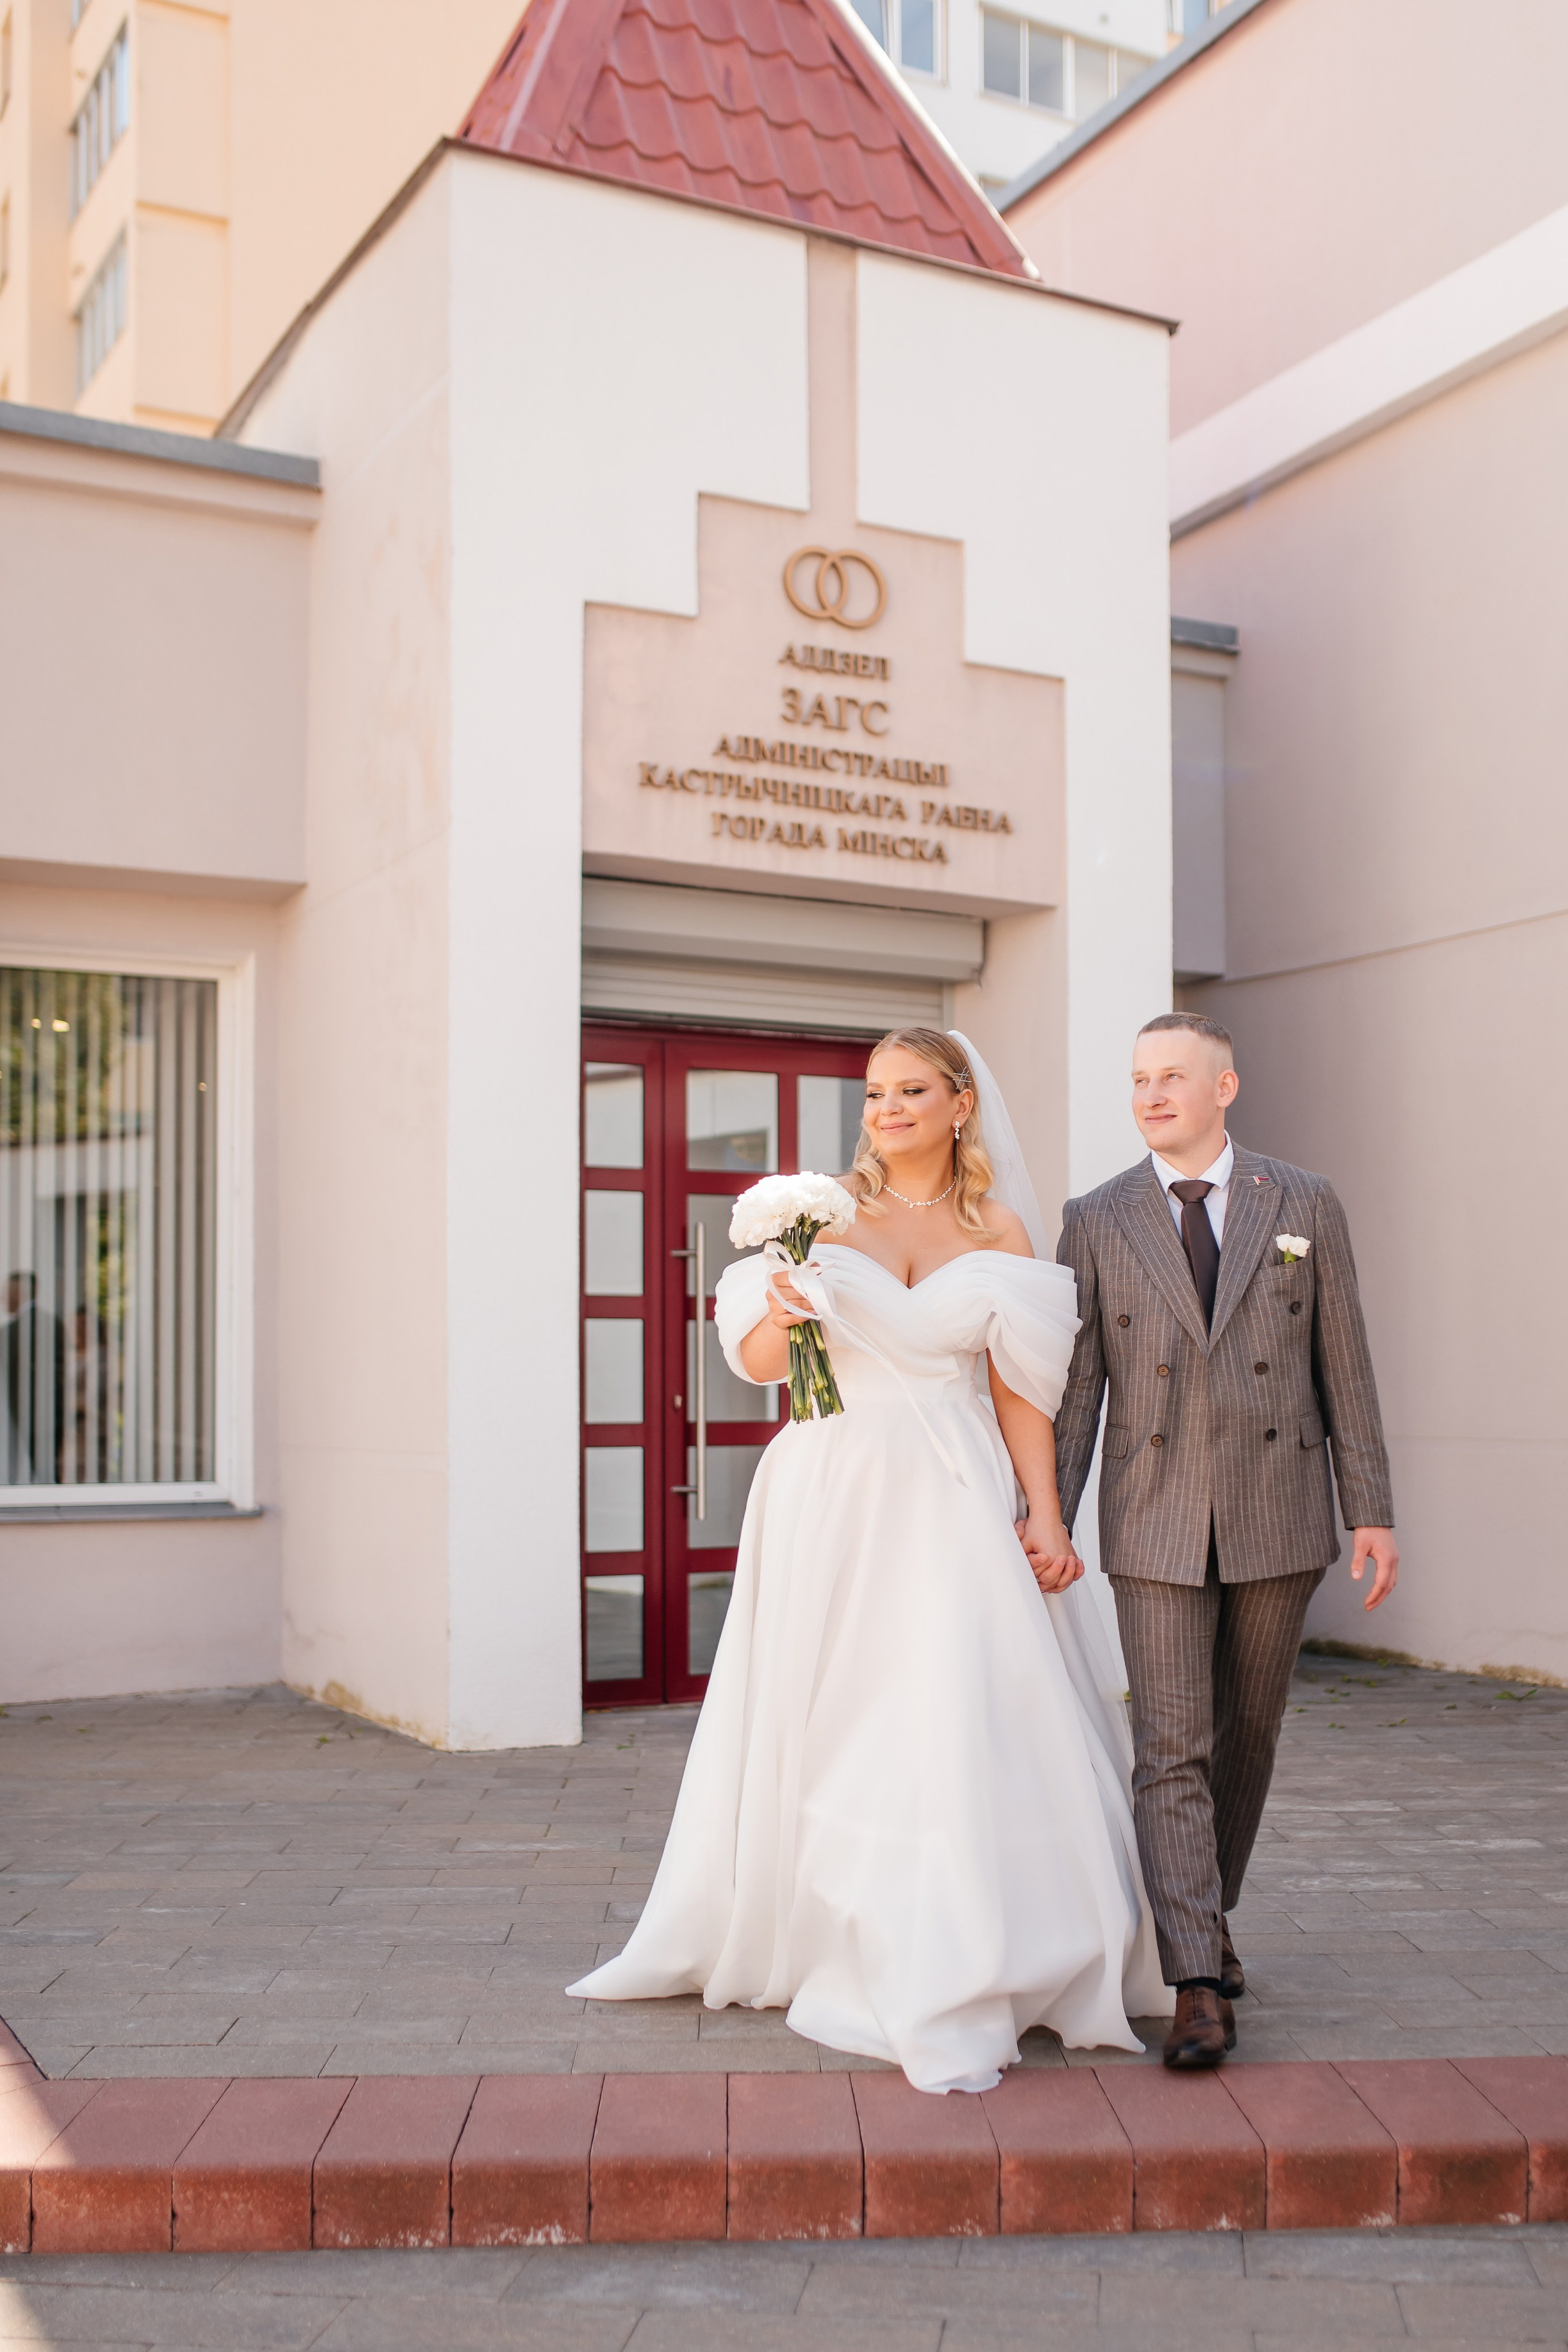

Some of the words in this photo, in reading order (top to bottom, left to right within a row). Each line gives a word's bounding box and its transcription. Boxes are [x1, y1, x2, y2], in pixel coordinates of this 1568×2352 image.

[778, 643, 891, 682] АДДЗЕЛ
[780, 687, 890, 737] ЗАГС
[712, 812, 827, 849] ГОРАДА
[837, 827, 949, 864] МІНСКА
